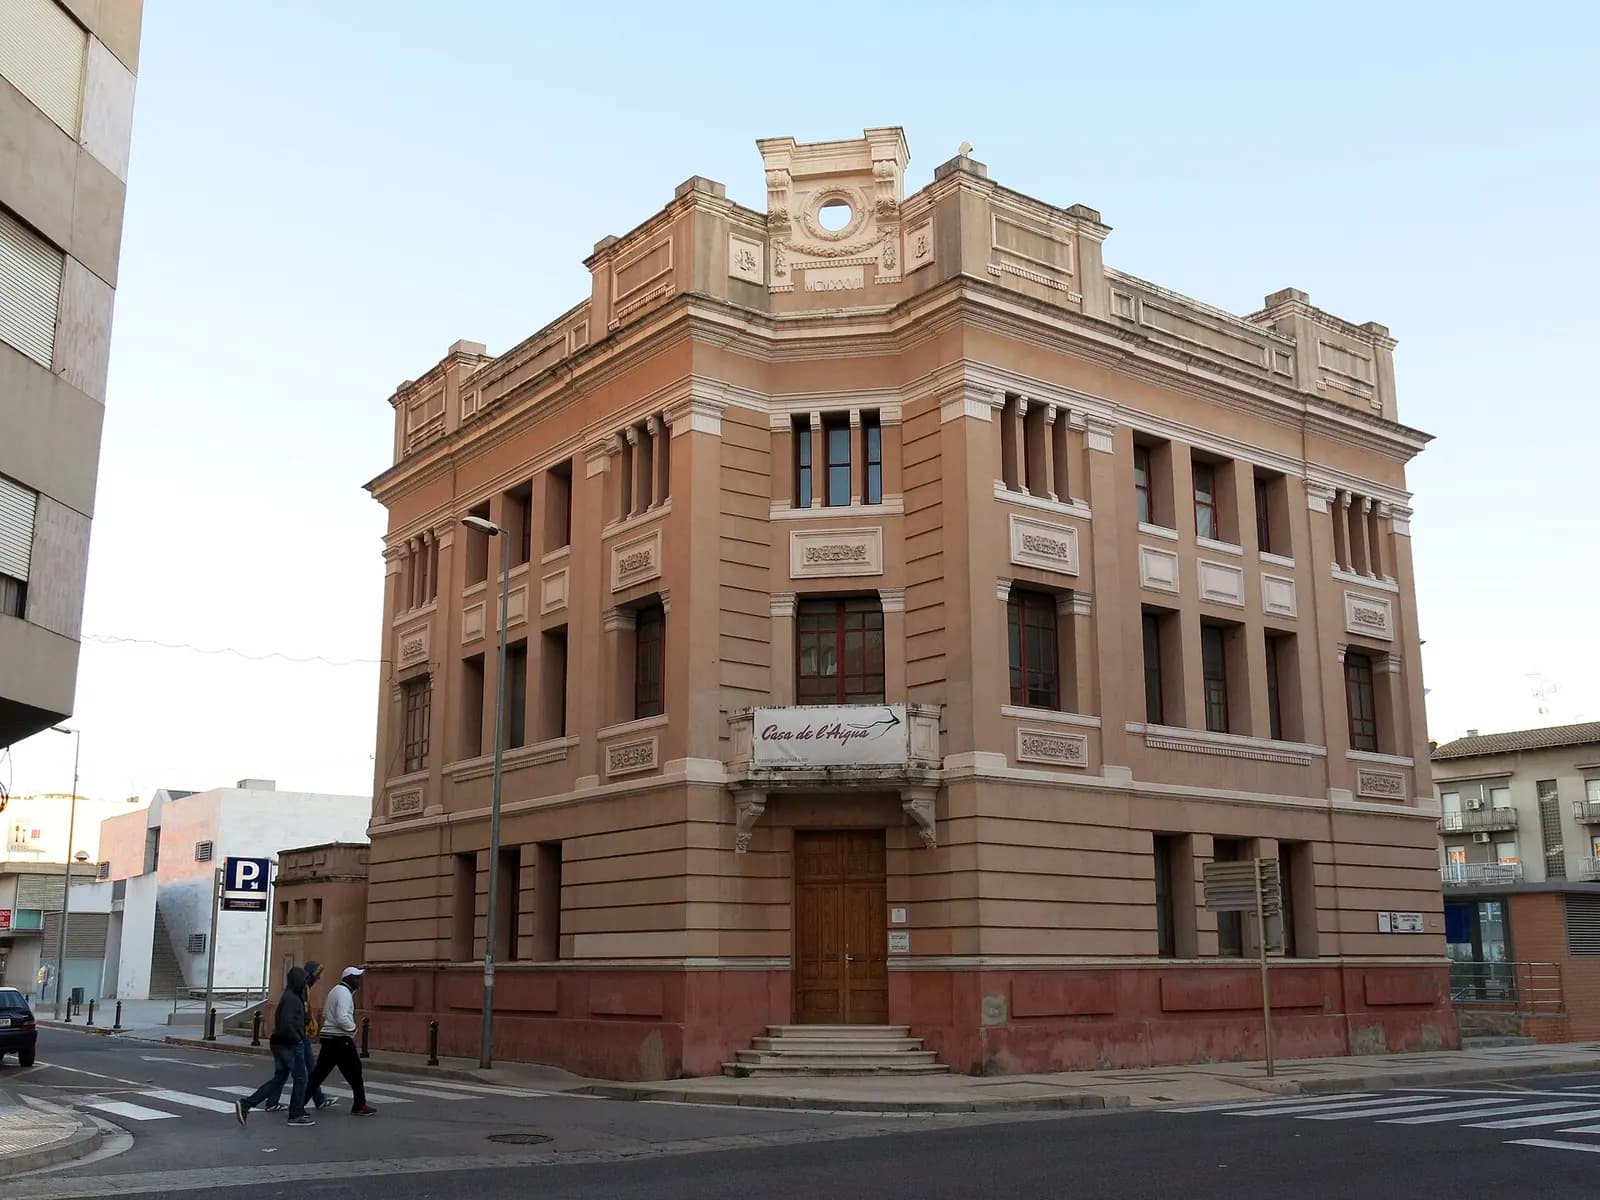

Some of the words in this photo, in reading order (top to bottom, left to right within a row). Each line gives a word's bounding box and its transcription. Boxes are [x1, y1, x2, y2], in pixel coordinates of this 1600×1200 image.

[761, 724, 793, 740] Casa
[795, 724, 814, 740] de
[815, 722, 870, 746] l'Aigua
[235, 860, 260, 889] P
